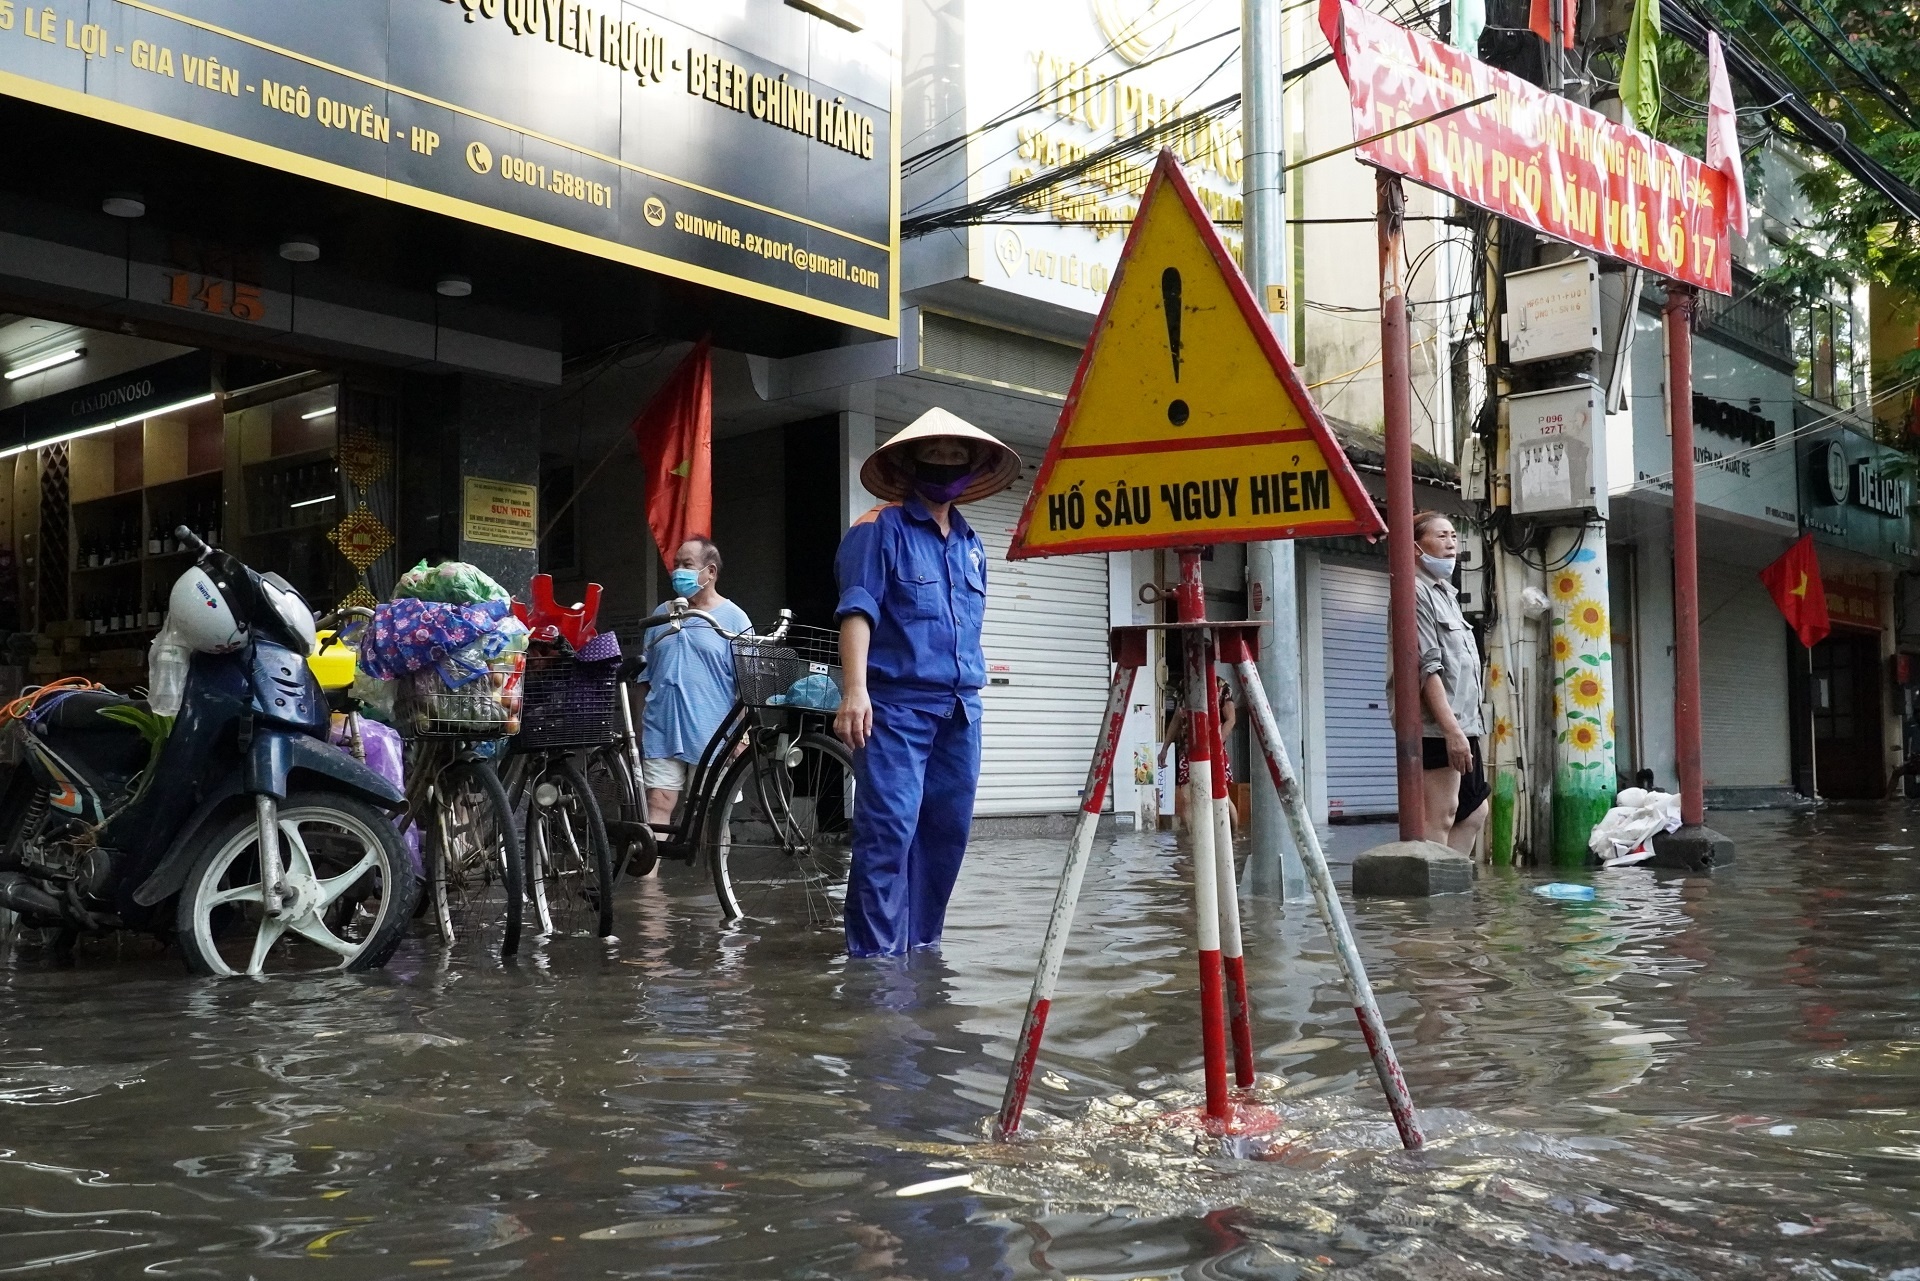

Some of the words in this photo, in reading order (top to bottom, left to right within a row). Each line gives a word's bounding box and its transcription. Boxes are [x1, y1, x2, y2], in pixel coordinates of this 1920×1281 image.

[24, 7, 56, 44] LÊ
[65, 19, 107, 60] LỢI
[131, 39, 174, 78] GIA
[182, 53, 239, 97] VIÊN
[262, 79, 311, 119] NGÔ
[317, 96, 390, 143] QUYỀN
[411, 126, 440, 157] HP
[687, 48, 747, 113] BEER
[749, 70, 816, 139] CHÍNH
[501, 154, 612, 209] 0901.588161
[1425, 120, 1484, 192] DÂN
[1491, 151, 1543, 215] PHỐ
[1549, 171, 1597, 237] VĂN
[1692, 233, 1716, 279] 17
[674, 210, 879, 290] sunwine.export@gmail.com
[1025, 247, 1057, 279] 147
[491, 504, 508, 515] SUN
[510, 506, 532, 518] WINE
[1048, 480, 1085, 531] HỐ
[1095, 480, 1151, 528] SÂU
[1160, 477, 1240, 523] NGUY
[1250, 454, 1330, 516] HIỂM
